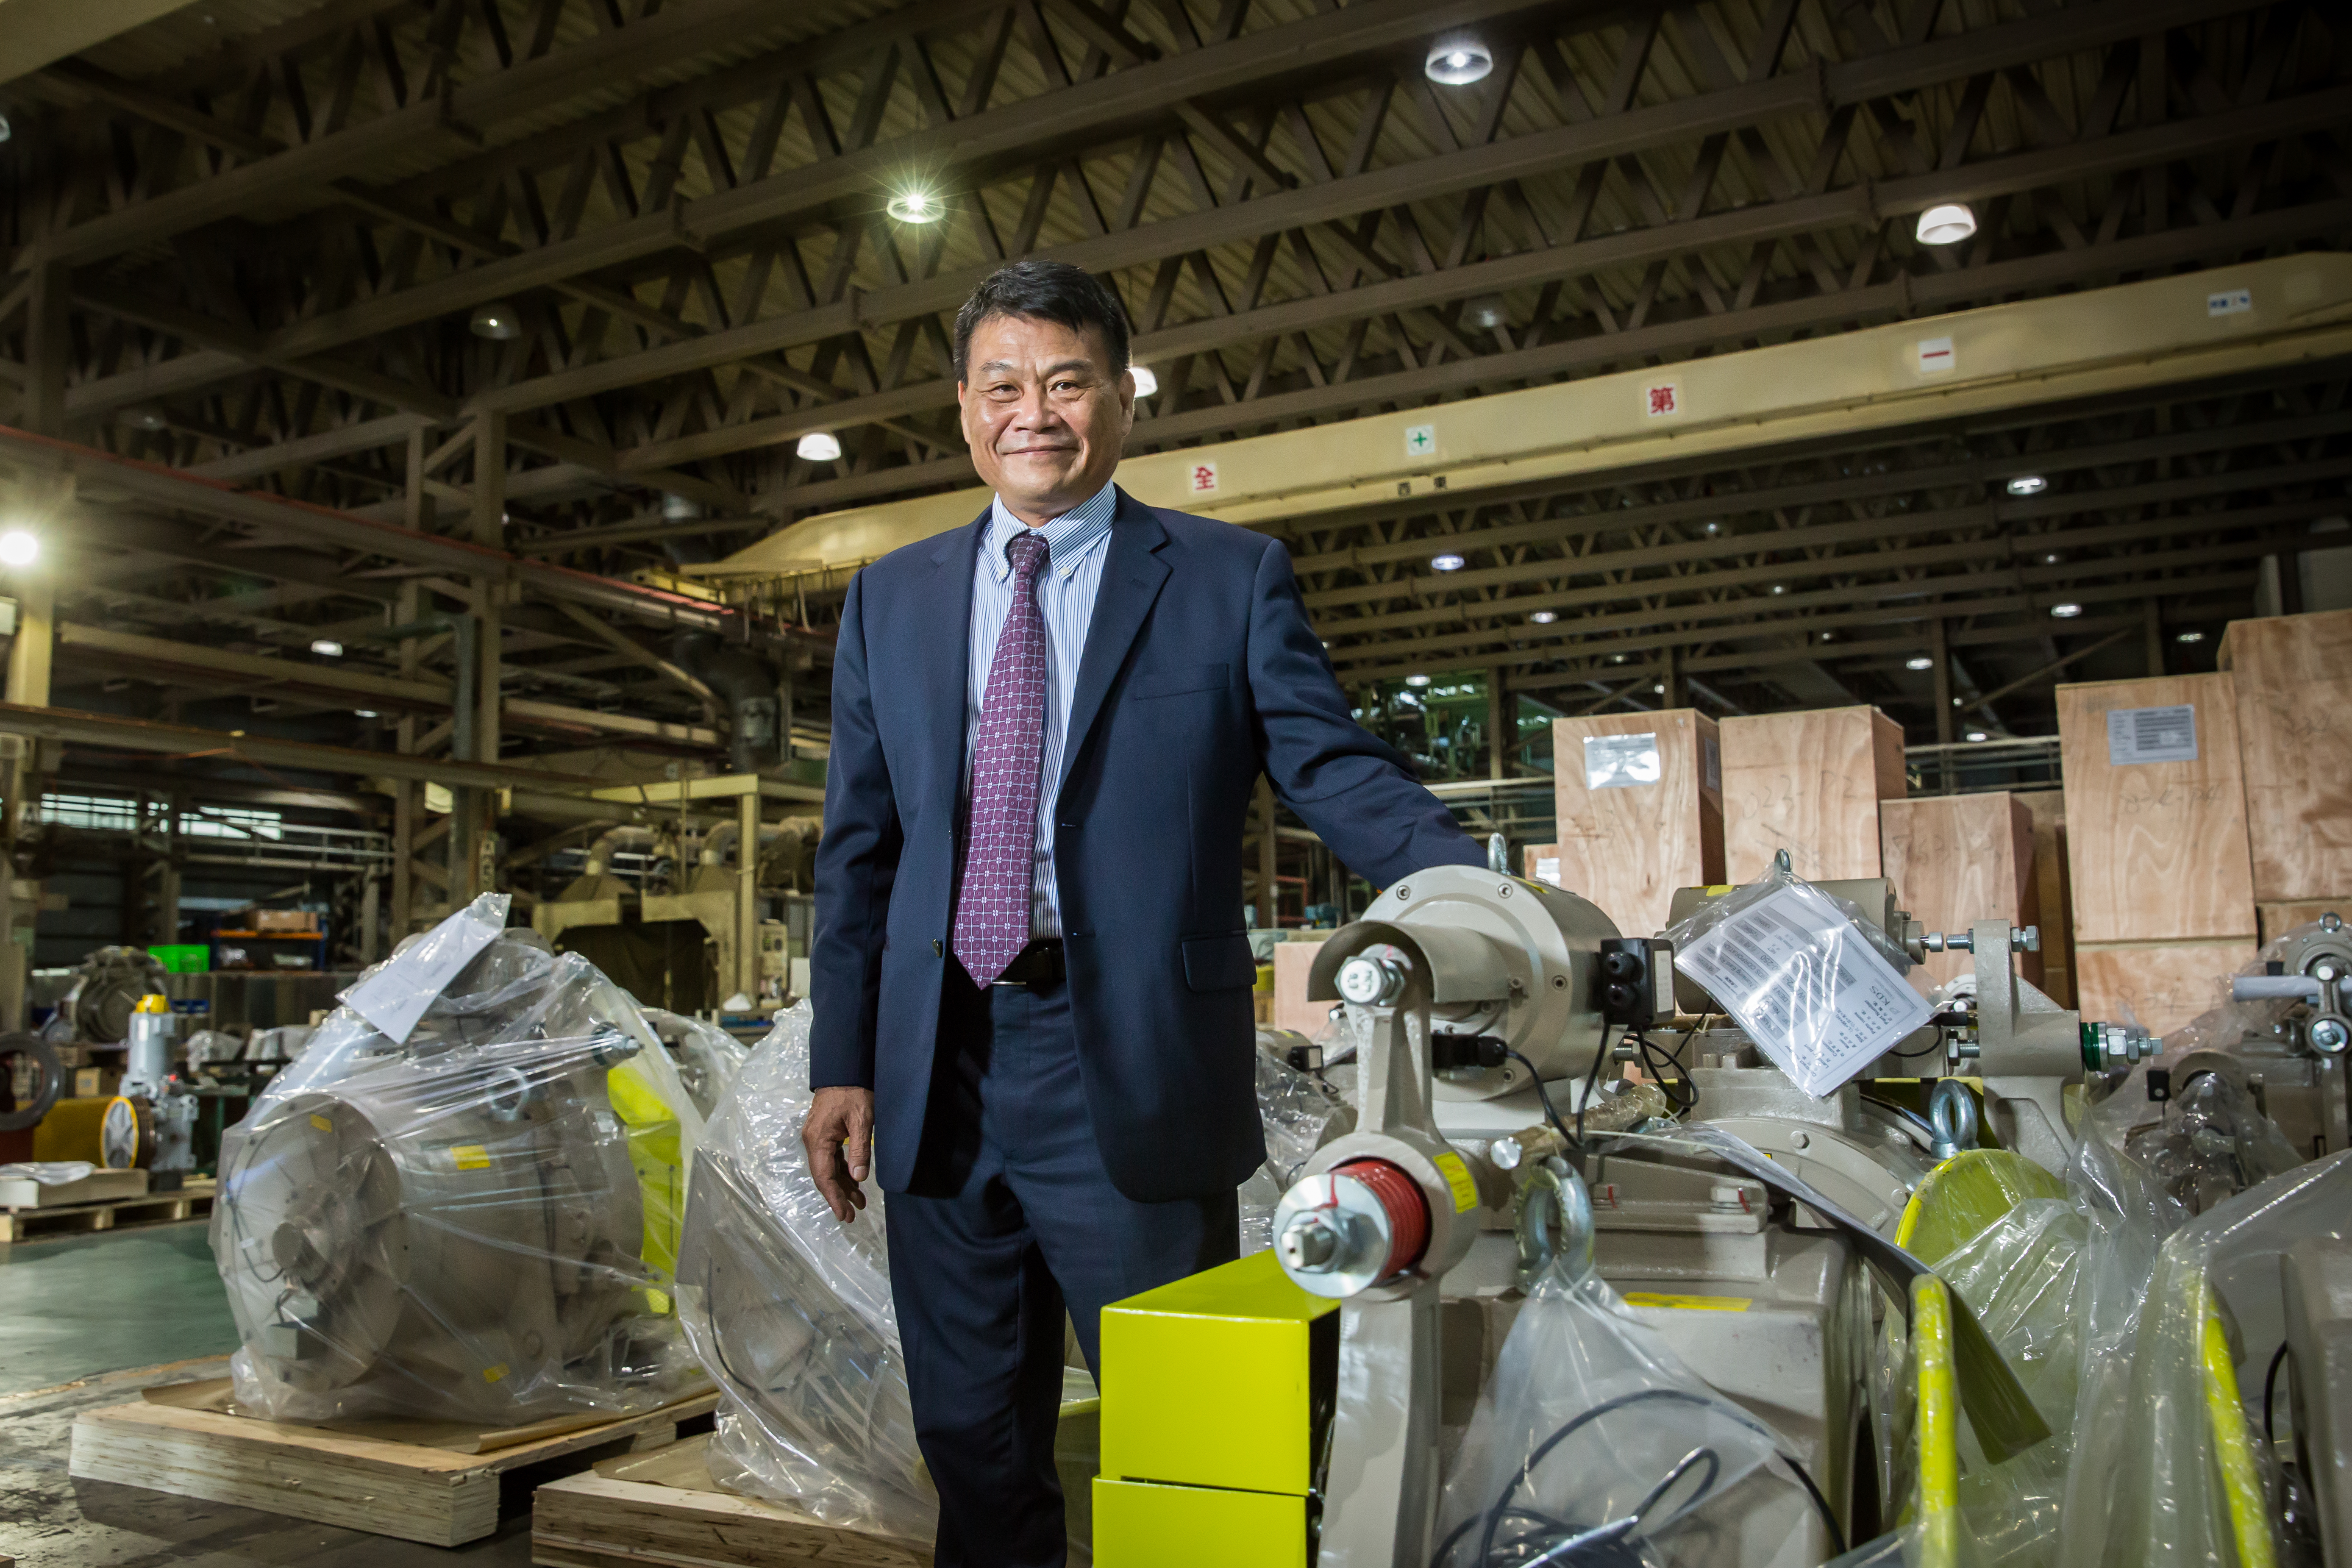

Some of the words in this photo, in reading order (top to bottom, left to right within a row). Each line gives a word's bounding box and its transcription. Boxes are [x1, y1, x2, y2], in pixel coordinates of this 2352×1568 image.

[1195, 466, 1214, 490] 全
[1649, 386, 1674, 414] 第
[1767, 946, 1777, 954] NET
[1868, 985, 1890, 1006] KDS
